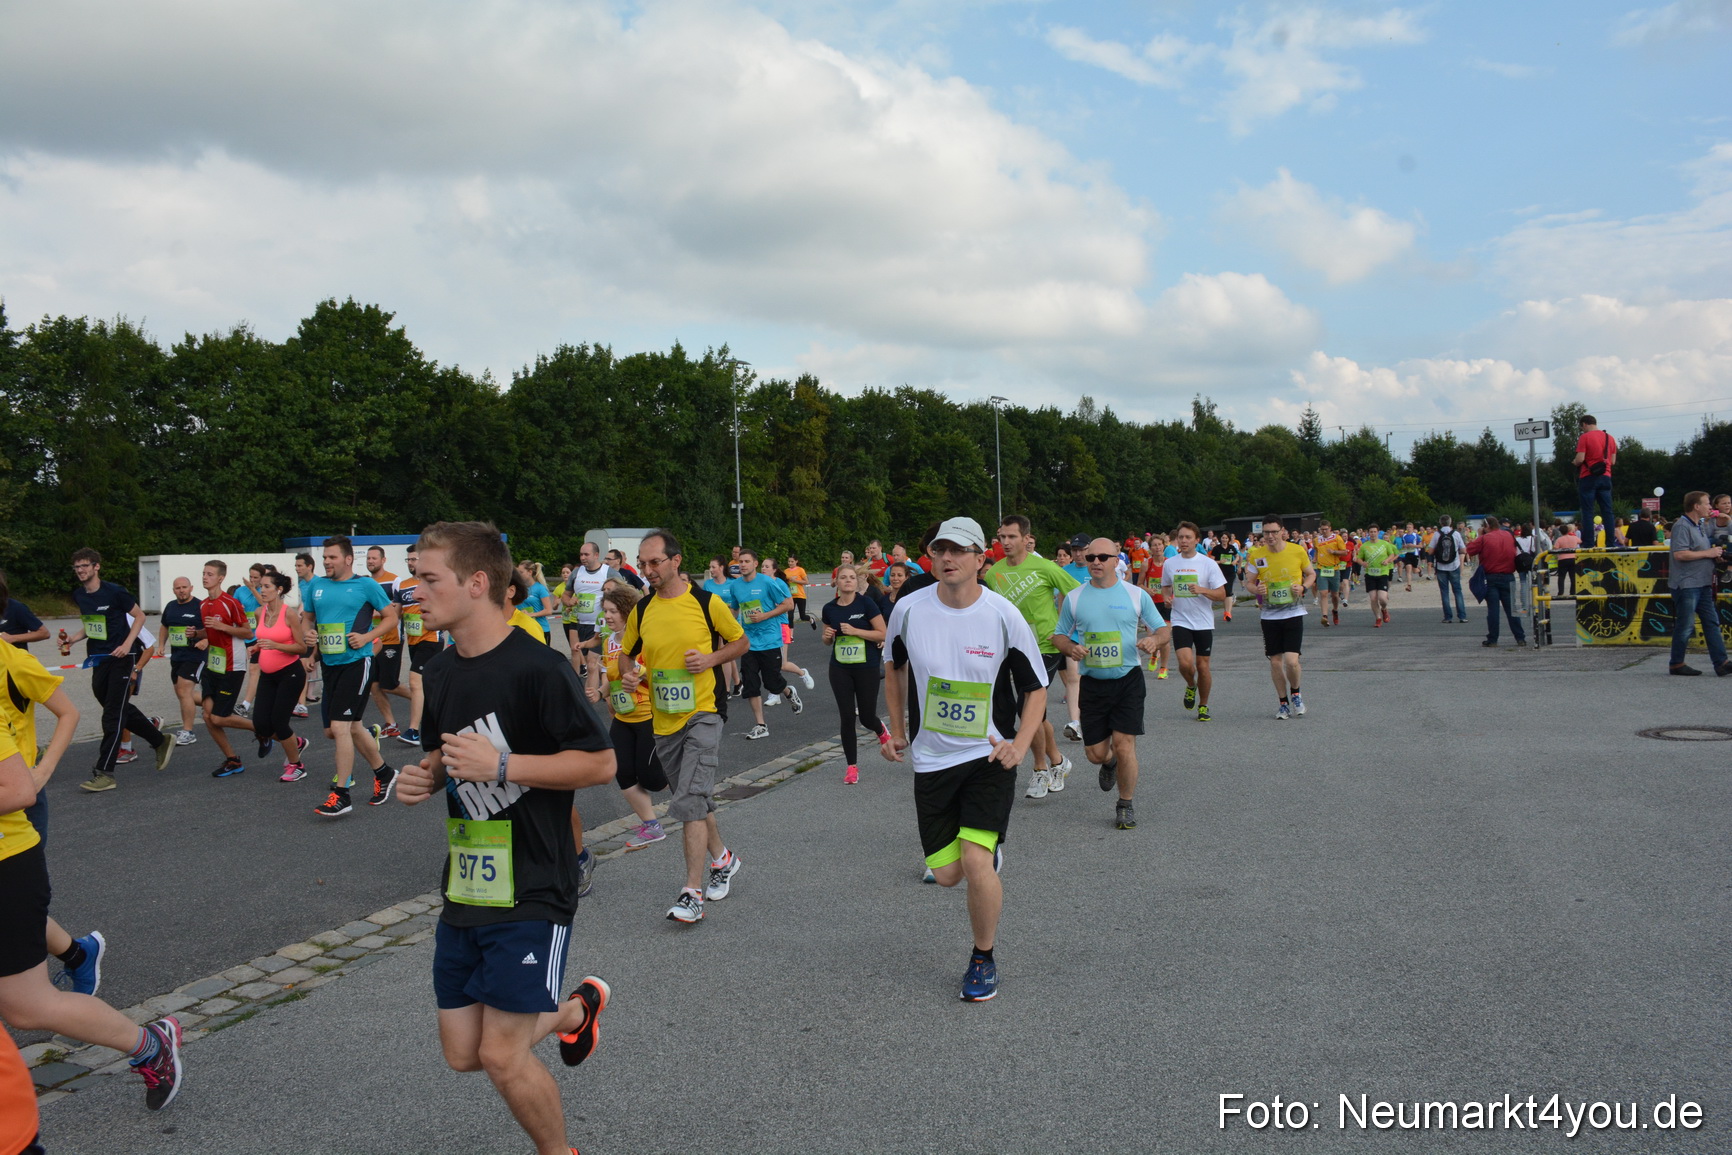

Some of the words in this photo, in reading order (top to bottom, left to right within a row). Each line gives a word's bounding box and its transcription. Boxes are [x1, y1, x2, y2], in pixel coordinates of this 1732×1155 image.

[1517, 427, 1530, 436] WC
[1271, 590, 1288, 598] 485
[88, 623, 103, 633] 718
[404, 620, 421, 631] 1648
[171, 633, 183, 641] 764
[319, 635, 343, 646] 1302
[840, 646, 859, 656] 707
[1088, 645, 1119, 658] 1498
[211, 655, 221, 666] 30
[655, 686, 691, 701] 1290
[936, 700, 976, 723] 385
[458, 852, 497, 882] 975
